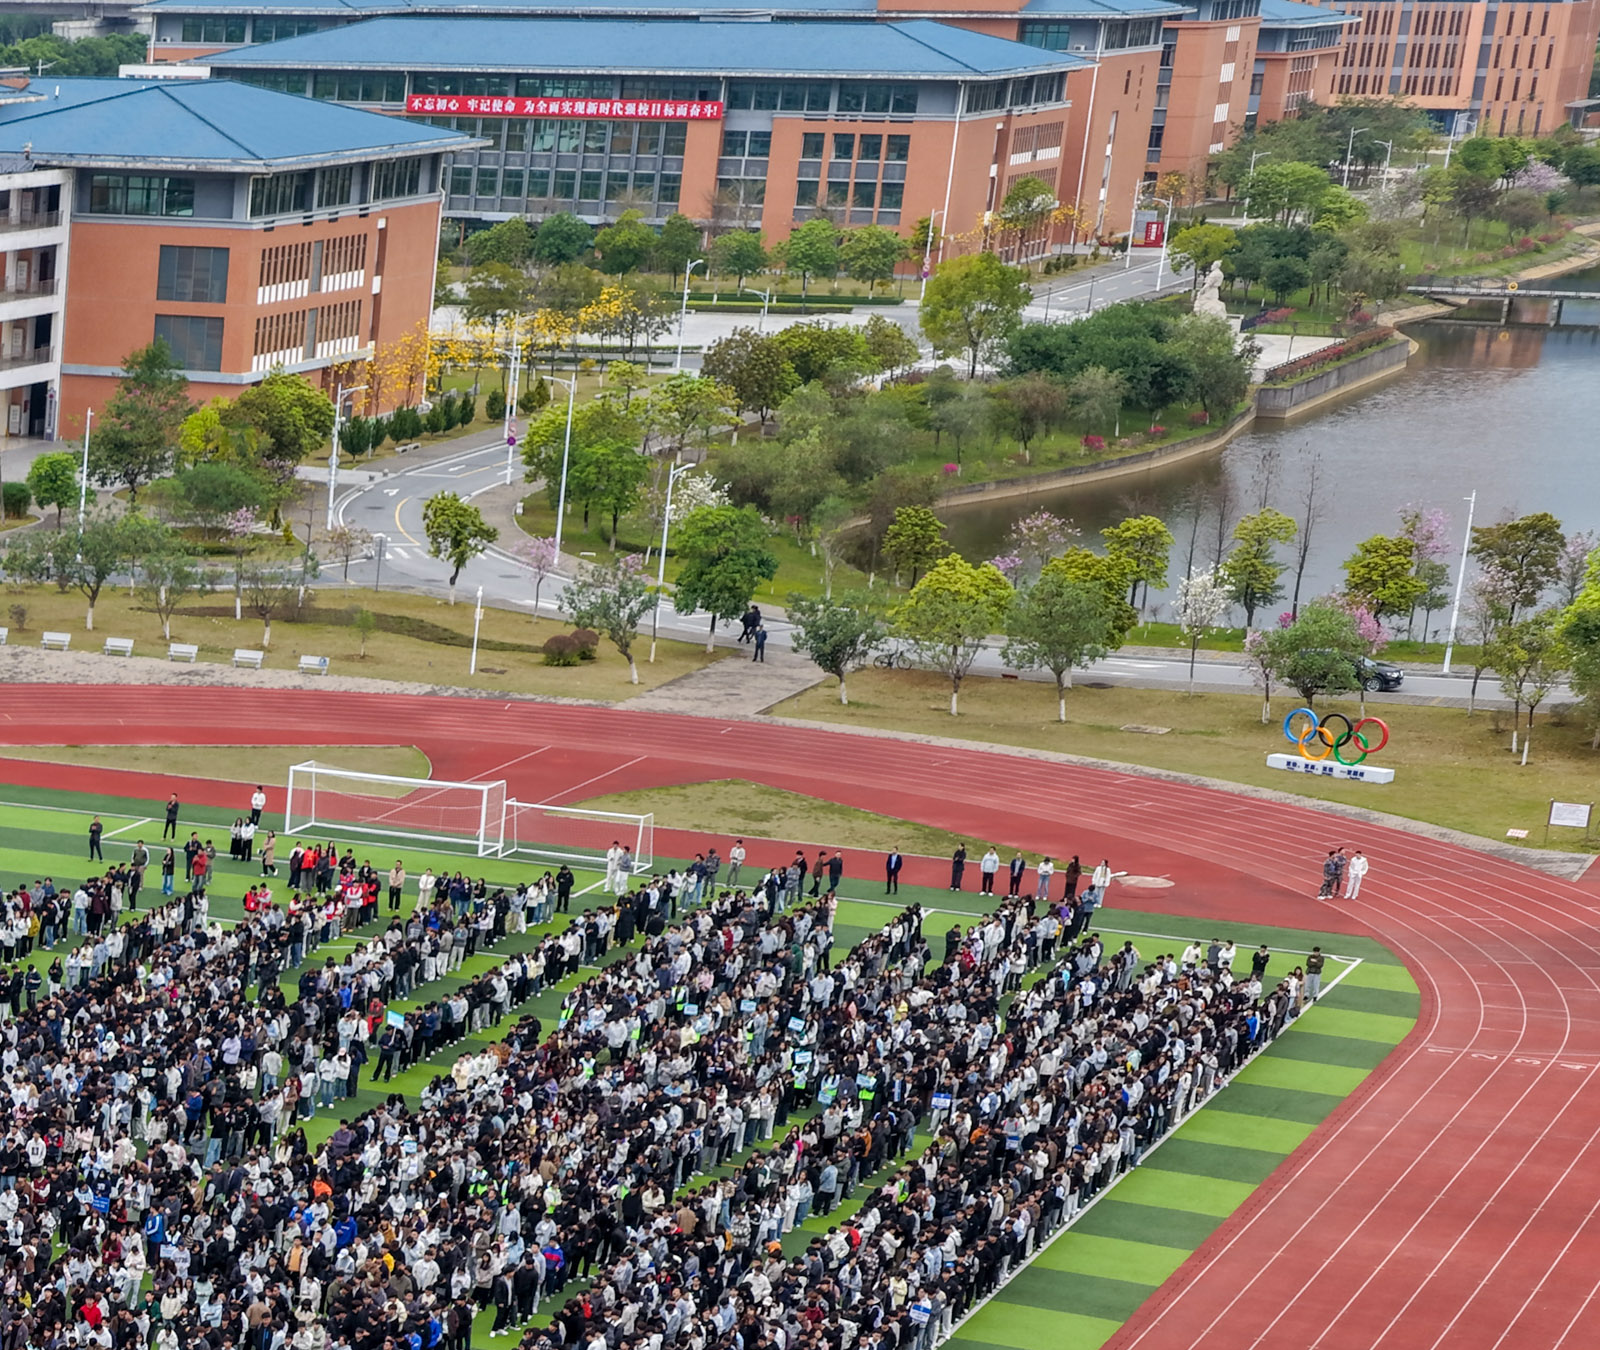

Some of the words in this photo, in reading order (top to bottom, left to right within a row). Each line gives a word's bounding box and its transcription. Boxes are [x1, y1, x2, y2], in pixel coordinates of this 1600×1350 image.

[410, 97, 459, 111] 不忘初心
[466, 99, 517, 112] 牢记使命
